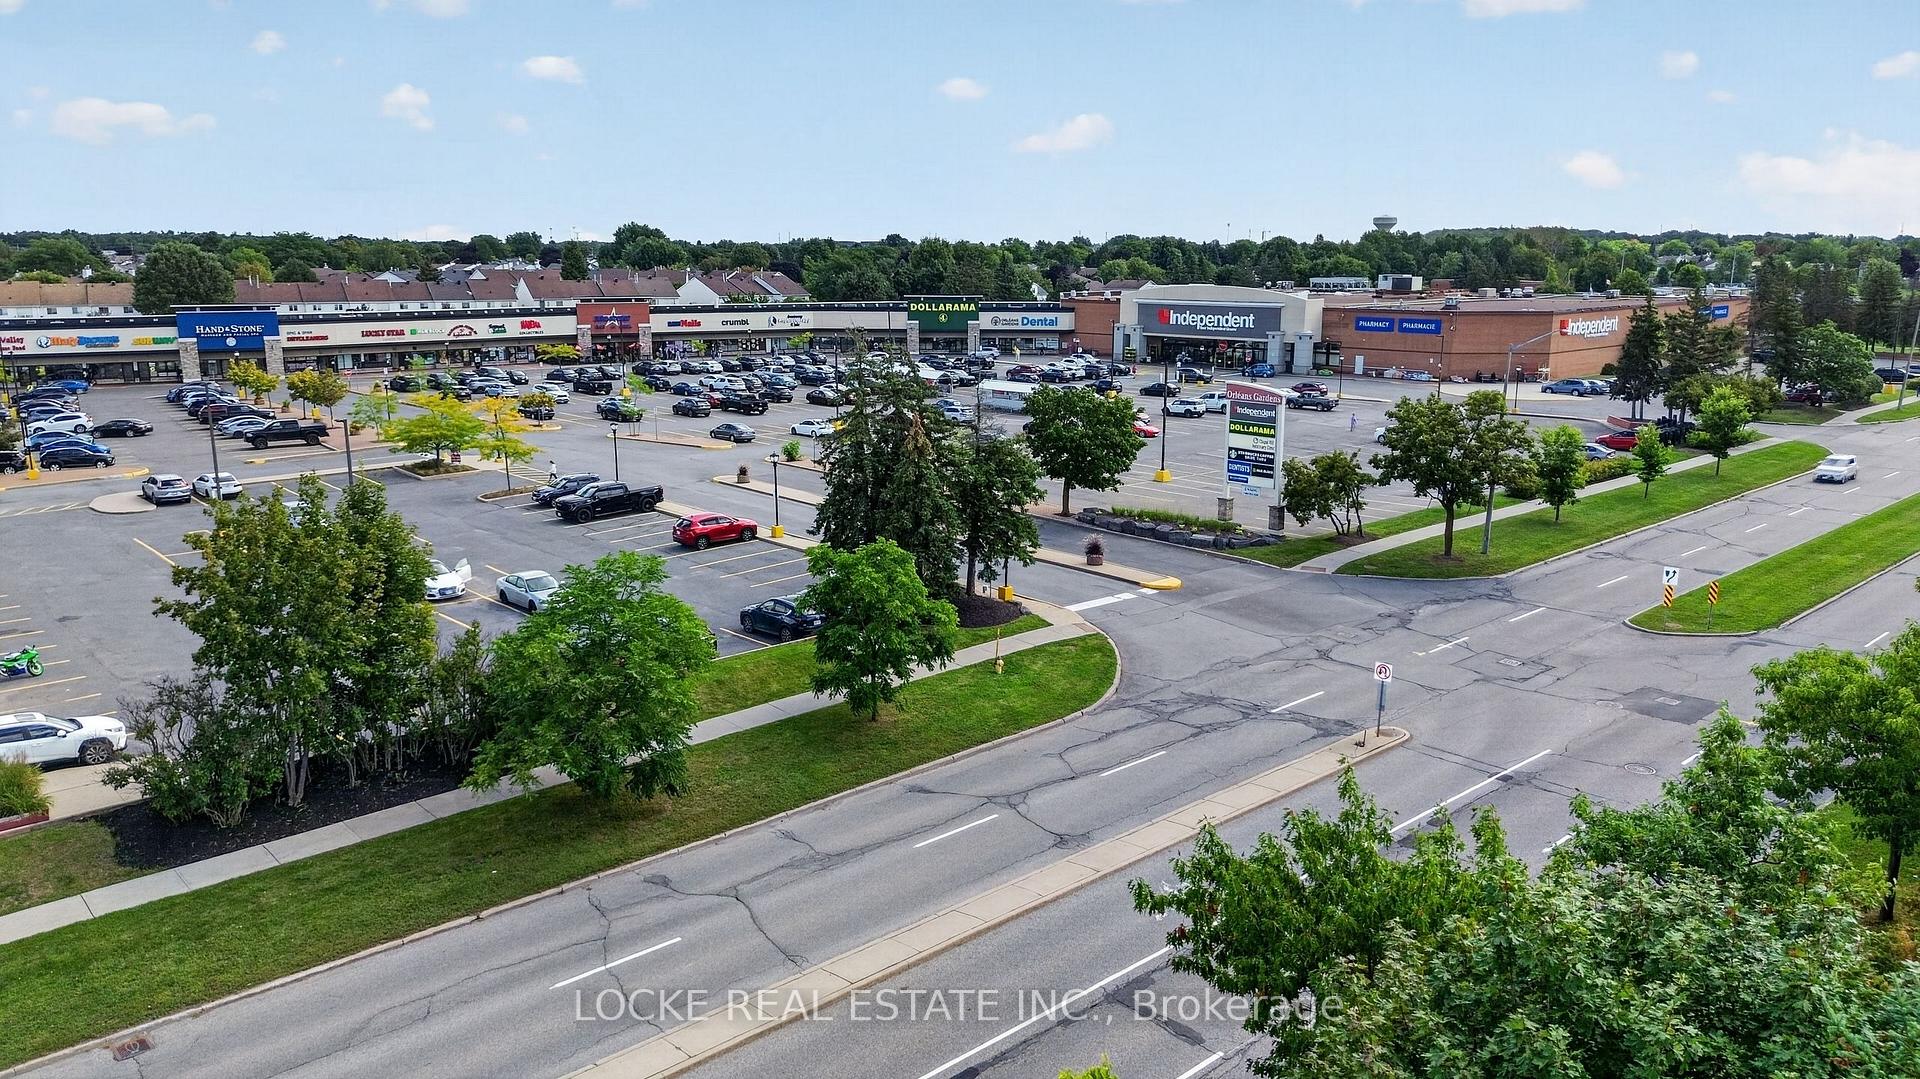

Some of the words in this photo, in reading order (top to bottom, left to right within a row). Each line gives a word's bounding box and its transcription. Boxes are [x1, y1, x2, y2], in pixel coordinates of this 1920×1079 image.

[910, 303, 976, 311] DOLLARAMA
[721, 318, 750, 326] crumbl
[1021, 316, 1058, 327] Dental
[1169, 310, 1255, 329] Independent
[1359, 320, 1390, 328] PHARMACY
[195, 325, 225, 334] HAND
[231, 324, 263, 333] STONE
[1402, 322, 1436, 330] PHARMACIE
[1567, 316, 1618, 338] Independent
[361, 330, 384, 338] LUCKY
[386, 329, 406, 337] STAR
[131, 336, 177, 346] SUBWAY
[1253, 392, 1281, 403] Gardens
[1236, 405, 1276, 417] Independent
[1230, 423, 1275, 435] DOLLARAMA
[1228, 463, 1250, 473] DENTISTS
